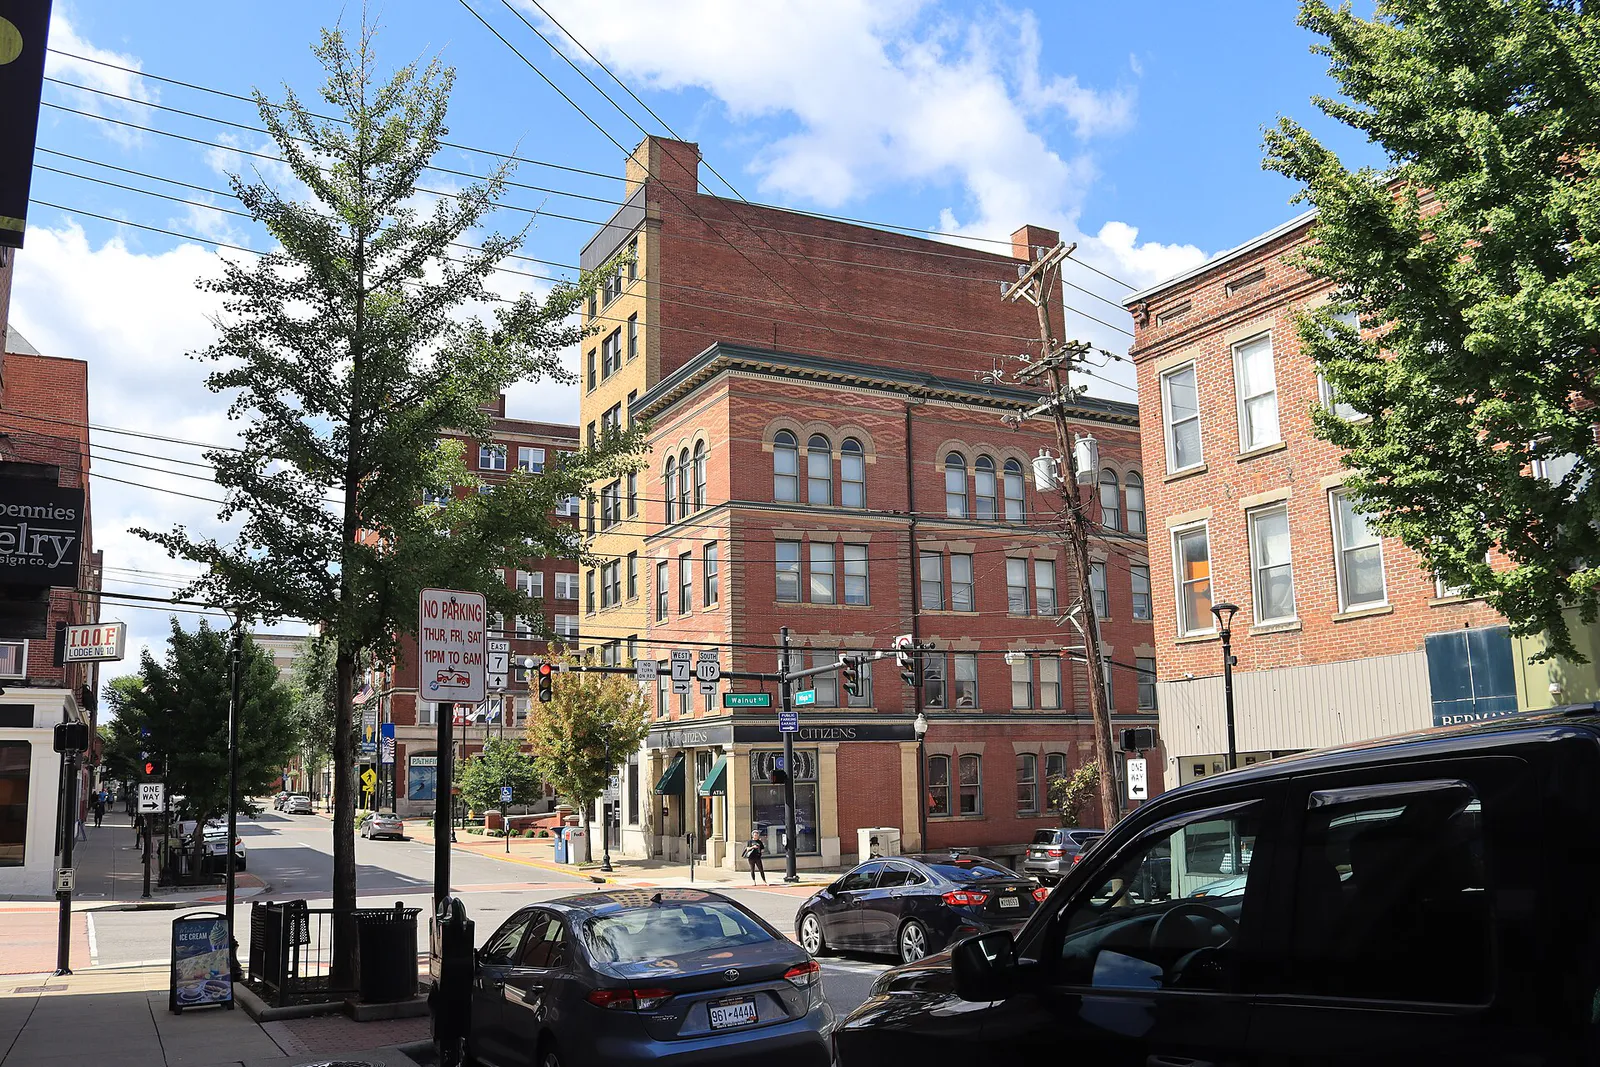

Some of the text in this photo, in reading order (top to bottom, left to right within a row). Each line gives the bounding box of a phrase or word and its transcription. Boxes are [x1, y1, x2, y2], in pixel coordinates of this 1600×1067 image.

[29, 557, 48, 566] co.
[424, 599, 482, 622] NO PARKING
[424, 627, 482, 646] THUR, FRI, SAT
[490, 642, 506, 650] EAST
[69, 648, 93, 657] LODGE
[106, 646, 115, 655] 10
[700, 652, 717, 660] SOUTH
[424, 649, 482, 666] 11PM TO 6AM
[495, 656, 503, 669] 7
[677, 665, 685, 677] 7
[701, 665, 715, 677] 119
[731, 696, 757, 704] Walnut
[799, 727, 857, 740] CITIZENS
[1130, 762, 1143, 772] ONE
[1130, 773, 1144, 782] WAY
[143, 785, 160, 793] ONE
[179, 932, 208, 942] ICE CREAM
